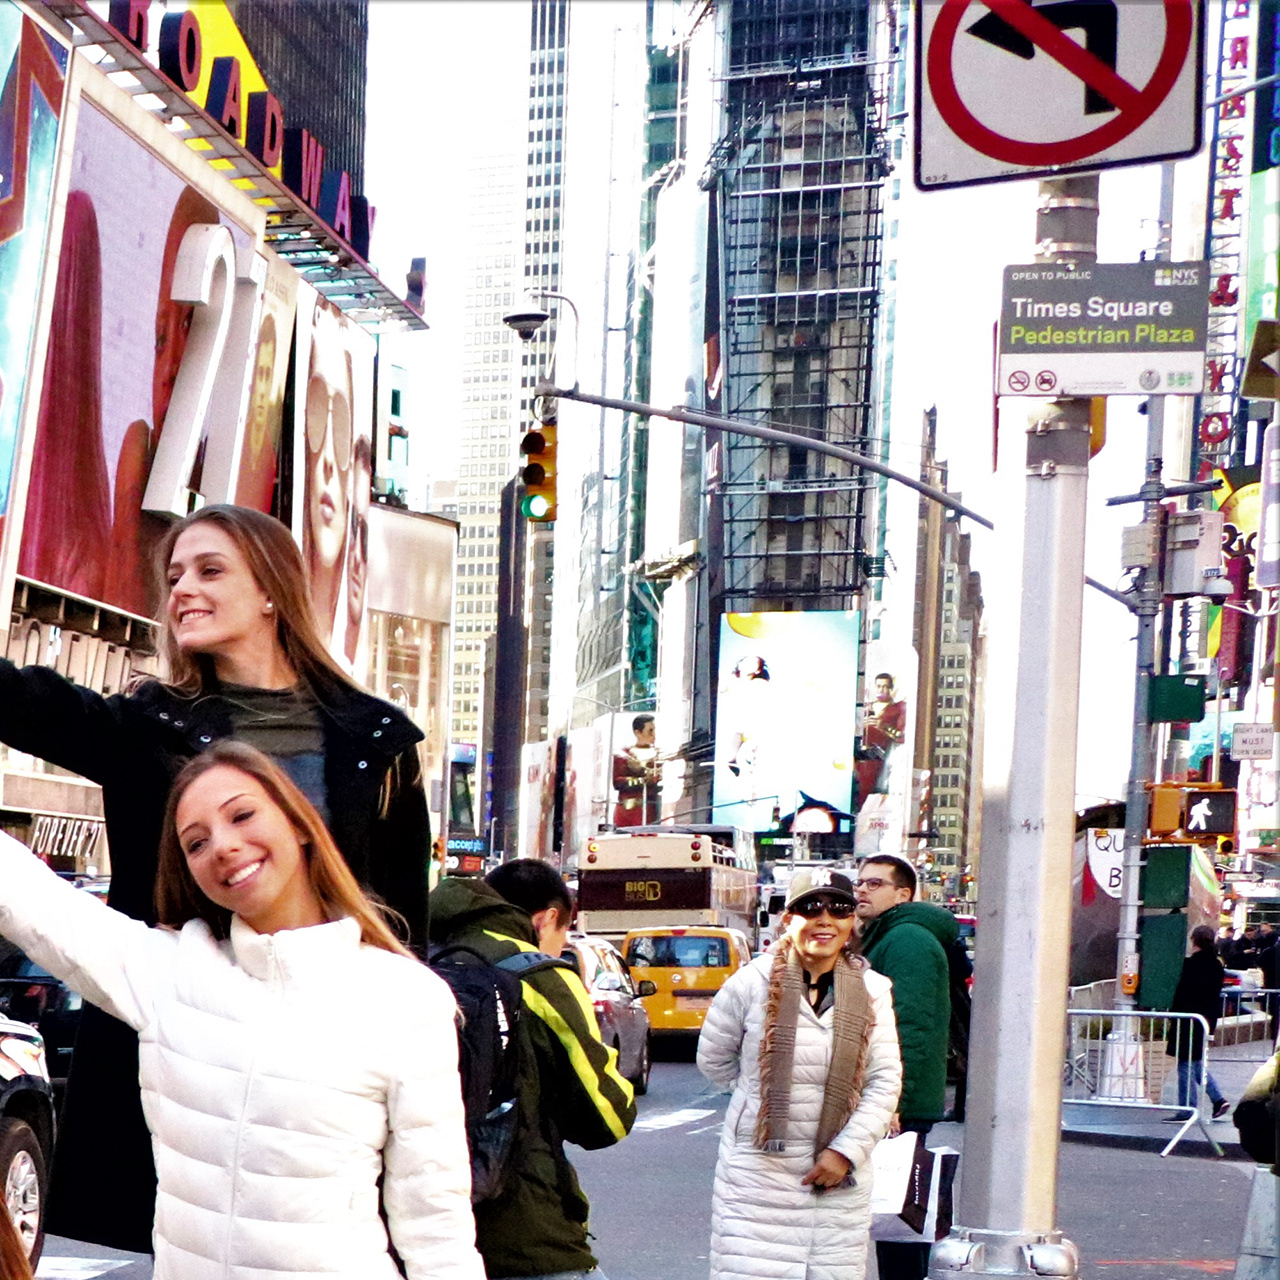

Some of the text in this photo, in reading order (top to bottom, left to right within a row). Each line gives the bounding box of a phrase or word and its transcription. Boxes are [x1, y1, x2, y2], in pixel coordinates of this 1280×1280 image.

[926, 174, 948, 183] R3-2
[1012, 271, 1091, 280] OPEN TO PUBLIC
[1172, 268, 1199, 279] NYC
[1011, 296, 1173, 321] Times Square
[1010, 324, 1195, 345] Pedestrian Plaza
[31, 816, 103, 858] FOREVER 21
[625, 881, 646, 892] BIG
